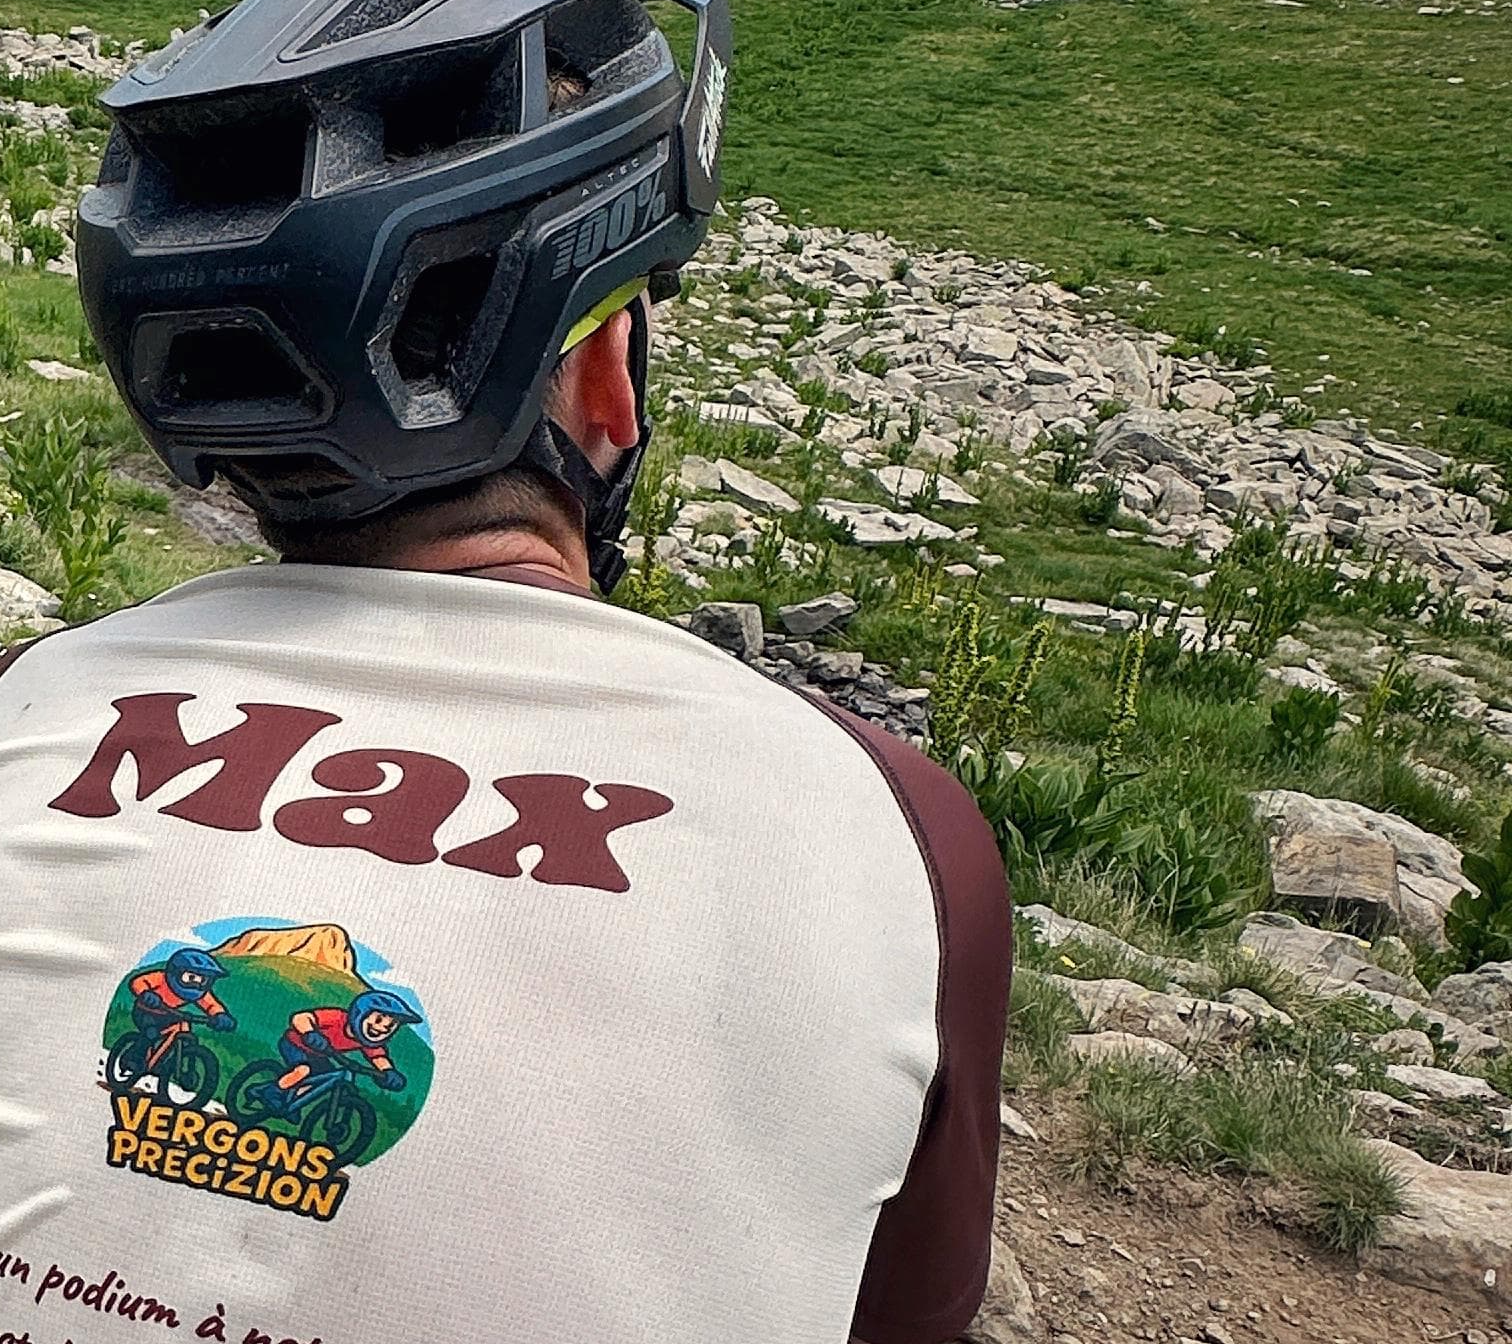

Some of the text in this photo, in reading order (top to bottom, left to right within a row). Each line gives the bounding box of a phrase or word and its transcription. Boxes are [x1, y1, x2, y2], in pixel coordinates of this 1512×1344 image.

[581, 157, 640, 197] ALTEC
[551, 167, 666, 280] 100%
[48, 692, 674, 893] Max
[116, 1095, 336, 1181] VERGONS
[34, 1264, 181, 1329] podium
[194, 1302, 226, 1344] à
